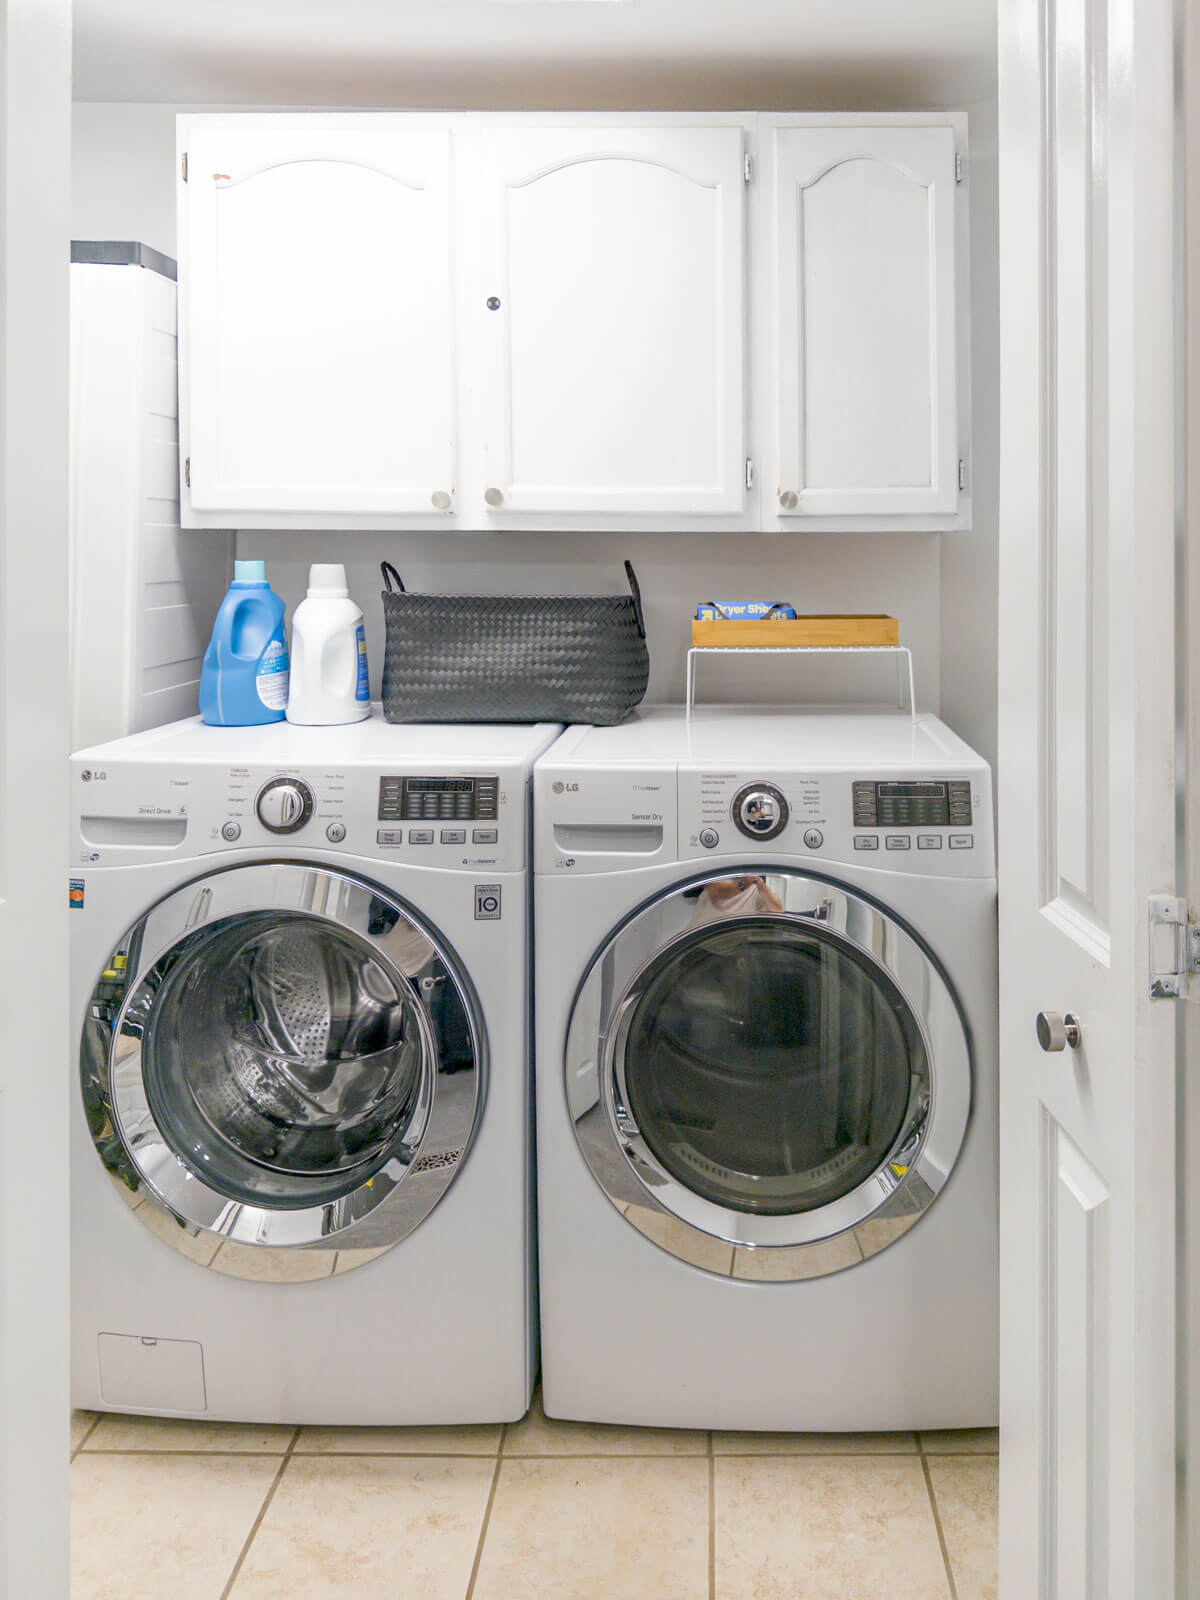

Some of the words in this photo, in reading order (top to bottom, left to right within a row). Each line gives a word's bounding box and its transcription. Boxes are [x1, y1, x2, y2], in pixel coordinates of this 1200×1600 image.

[94, 771, 107, 781] LG
[566, 783, 580, 792] LG
[138, 807, 155, 815] Direct
[156, 807, 171, 815] Drive
[632, 813, 650, 821] Sensor
[652, 813, 663, 822] Dry
[478, 897, 498, 912] 10
